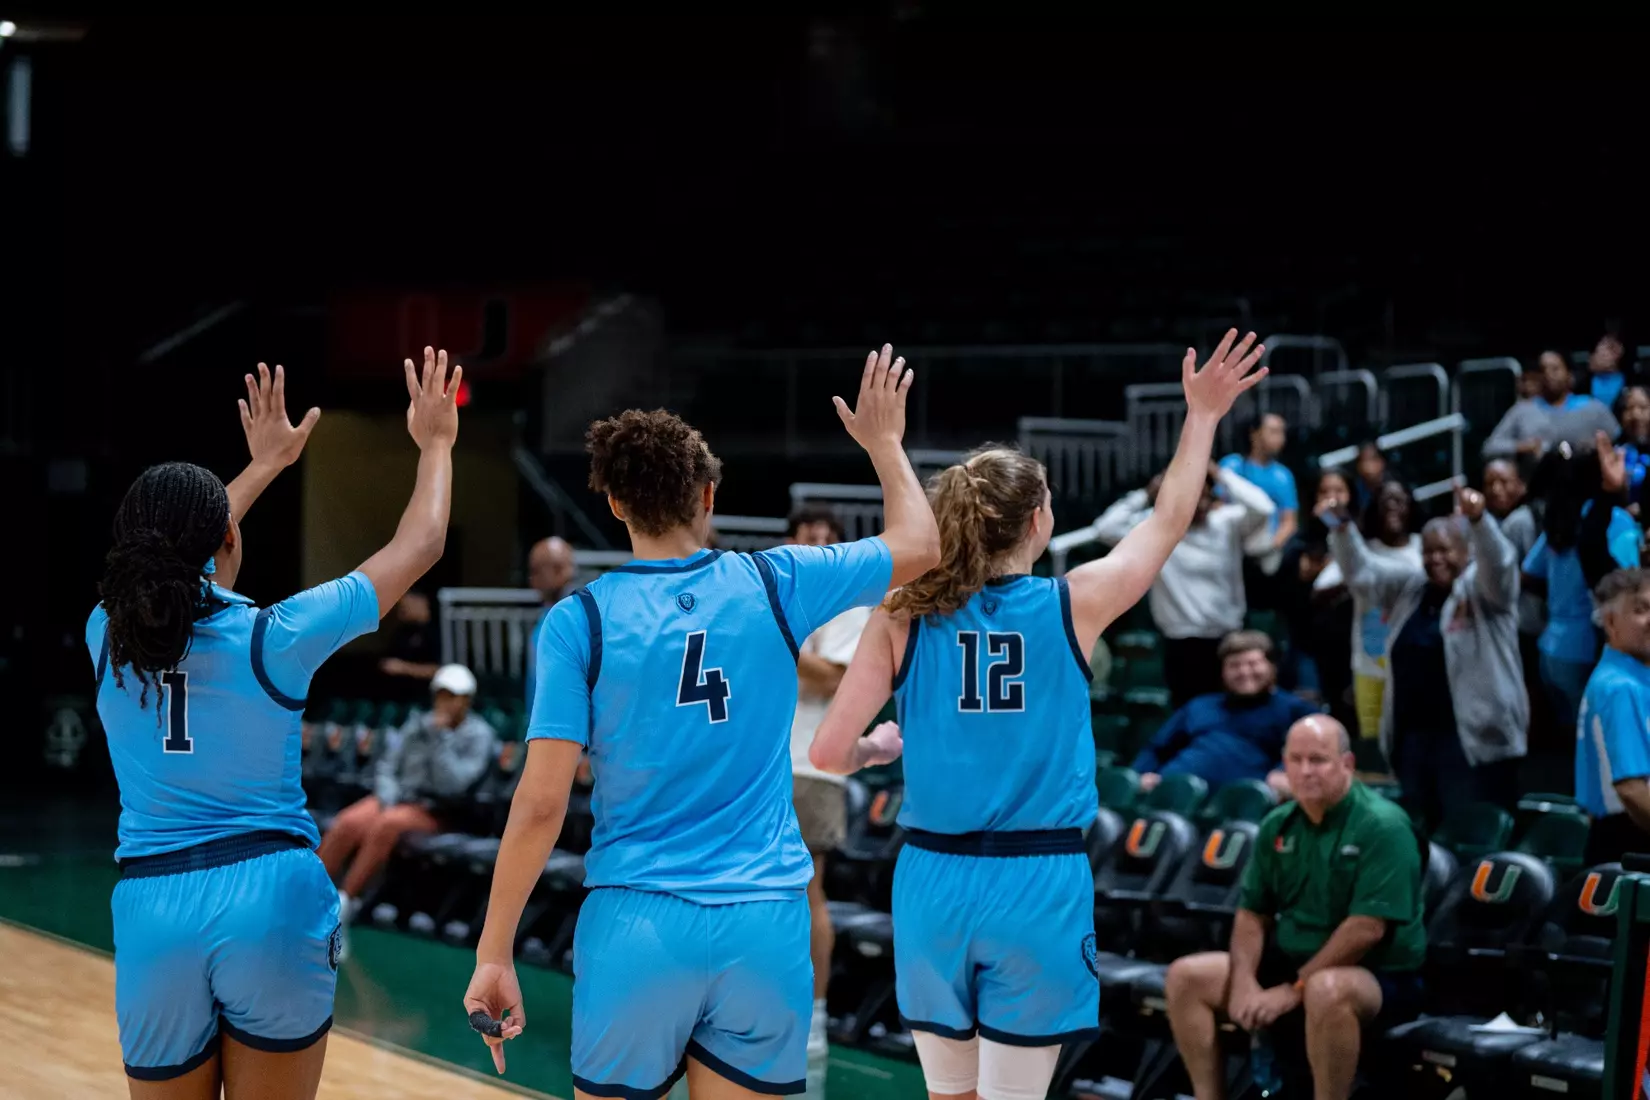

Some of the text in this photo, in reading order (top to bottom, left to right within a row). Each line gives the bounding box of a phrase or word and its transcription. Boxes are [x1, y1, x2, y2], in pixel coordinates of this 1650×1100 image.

[676, 630, 731, 724] 4
[957, 630, 1025, 712] 12
[161, 671, 194, 754] 1
[1126, 818, 1166, 858] U
[1203, 829, 1246, 869] U
[1471, 860, 1522, 903] U
[1579, 872, 1621, 916] U
